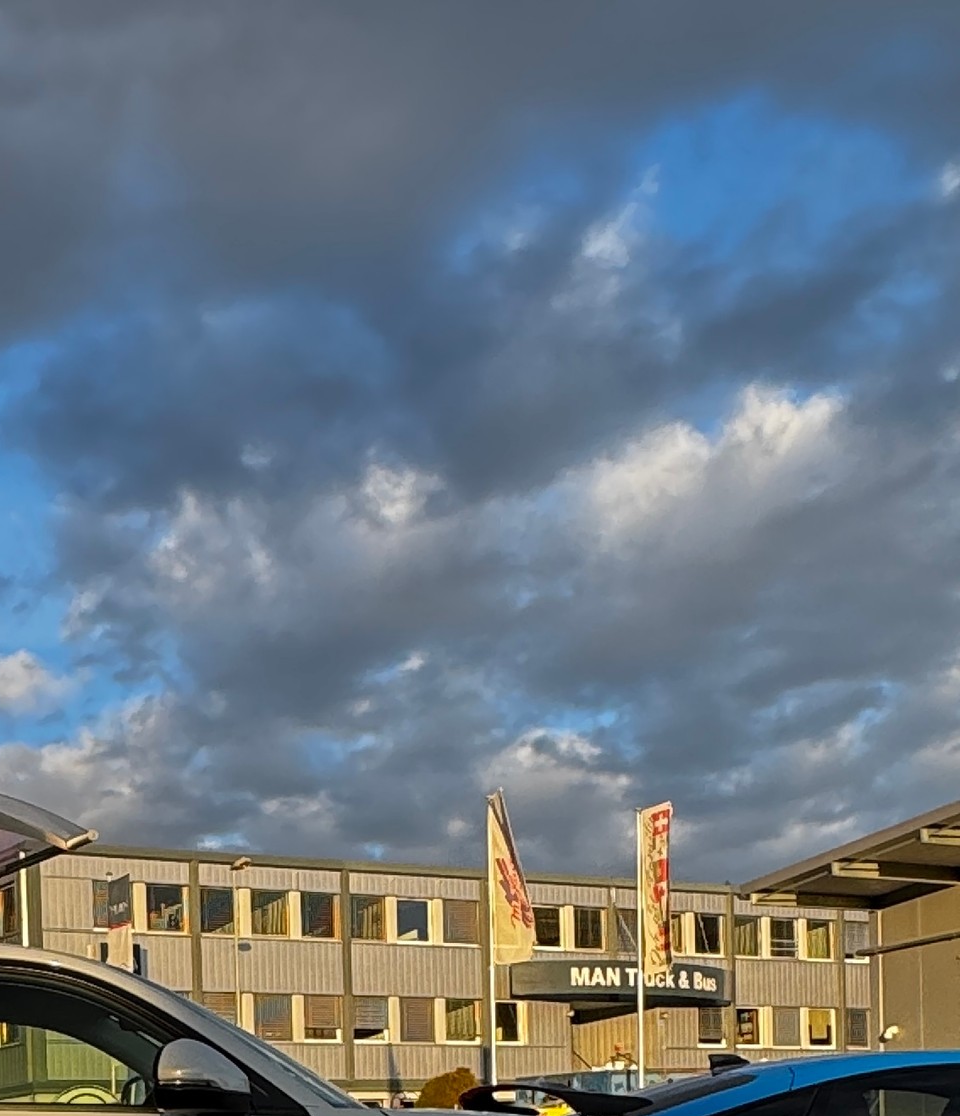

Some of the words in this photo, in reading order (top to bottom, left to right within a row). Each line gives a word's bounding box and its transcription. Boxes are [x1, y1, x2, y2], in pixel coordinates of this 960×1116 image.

[570, 967, 621, 987] MAN
[625, 968, 675, 989] Tuck
[678, 970, 690, 989] &
[693, 971, 717, 992] Bus
